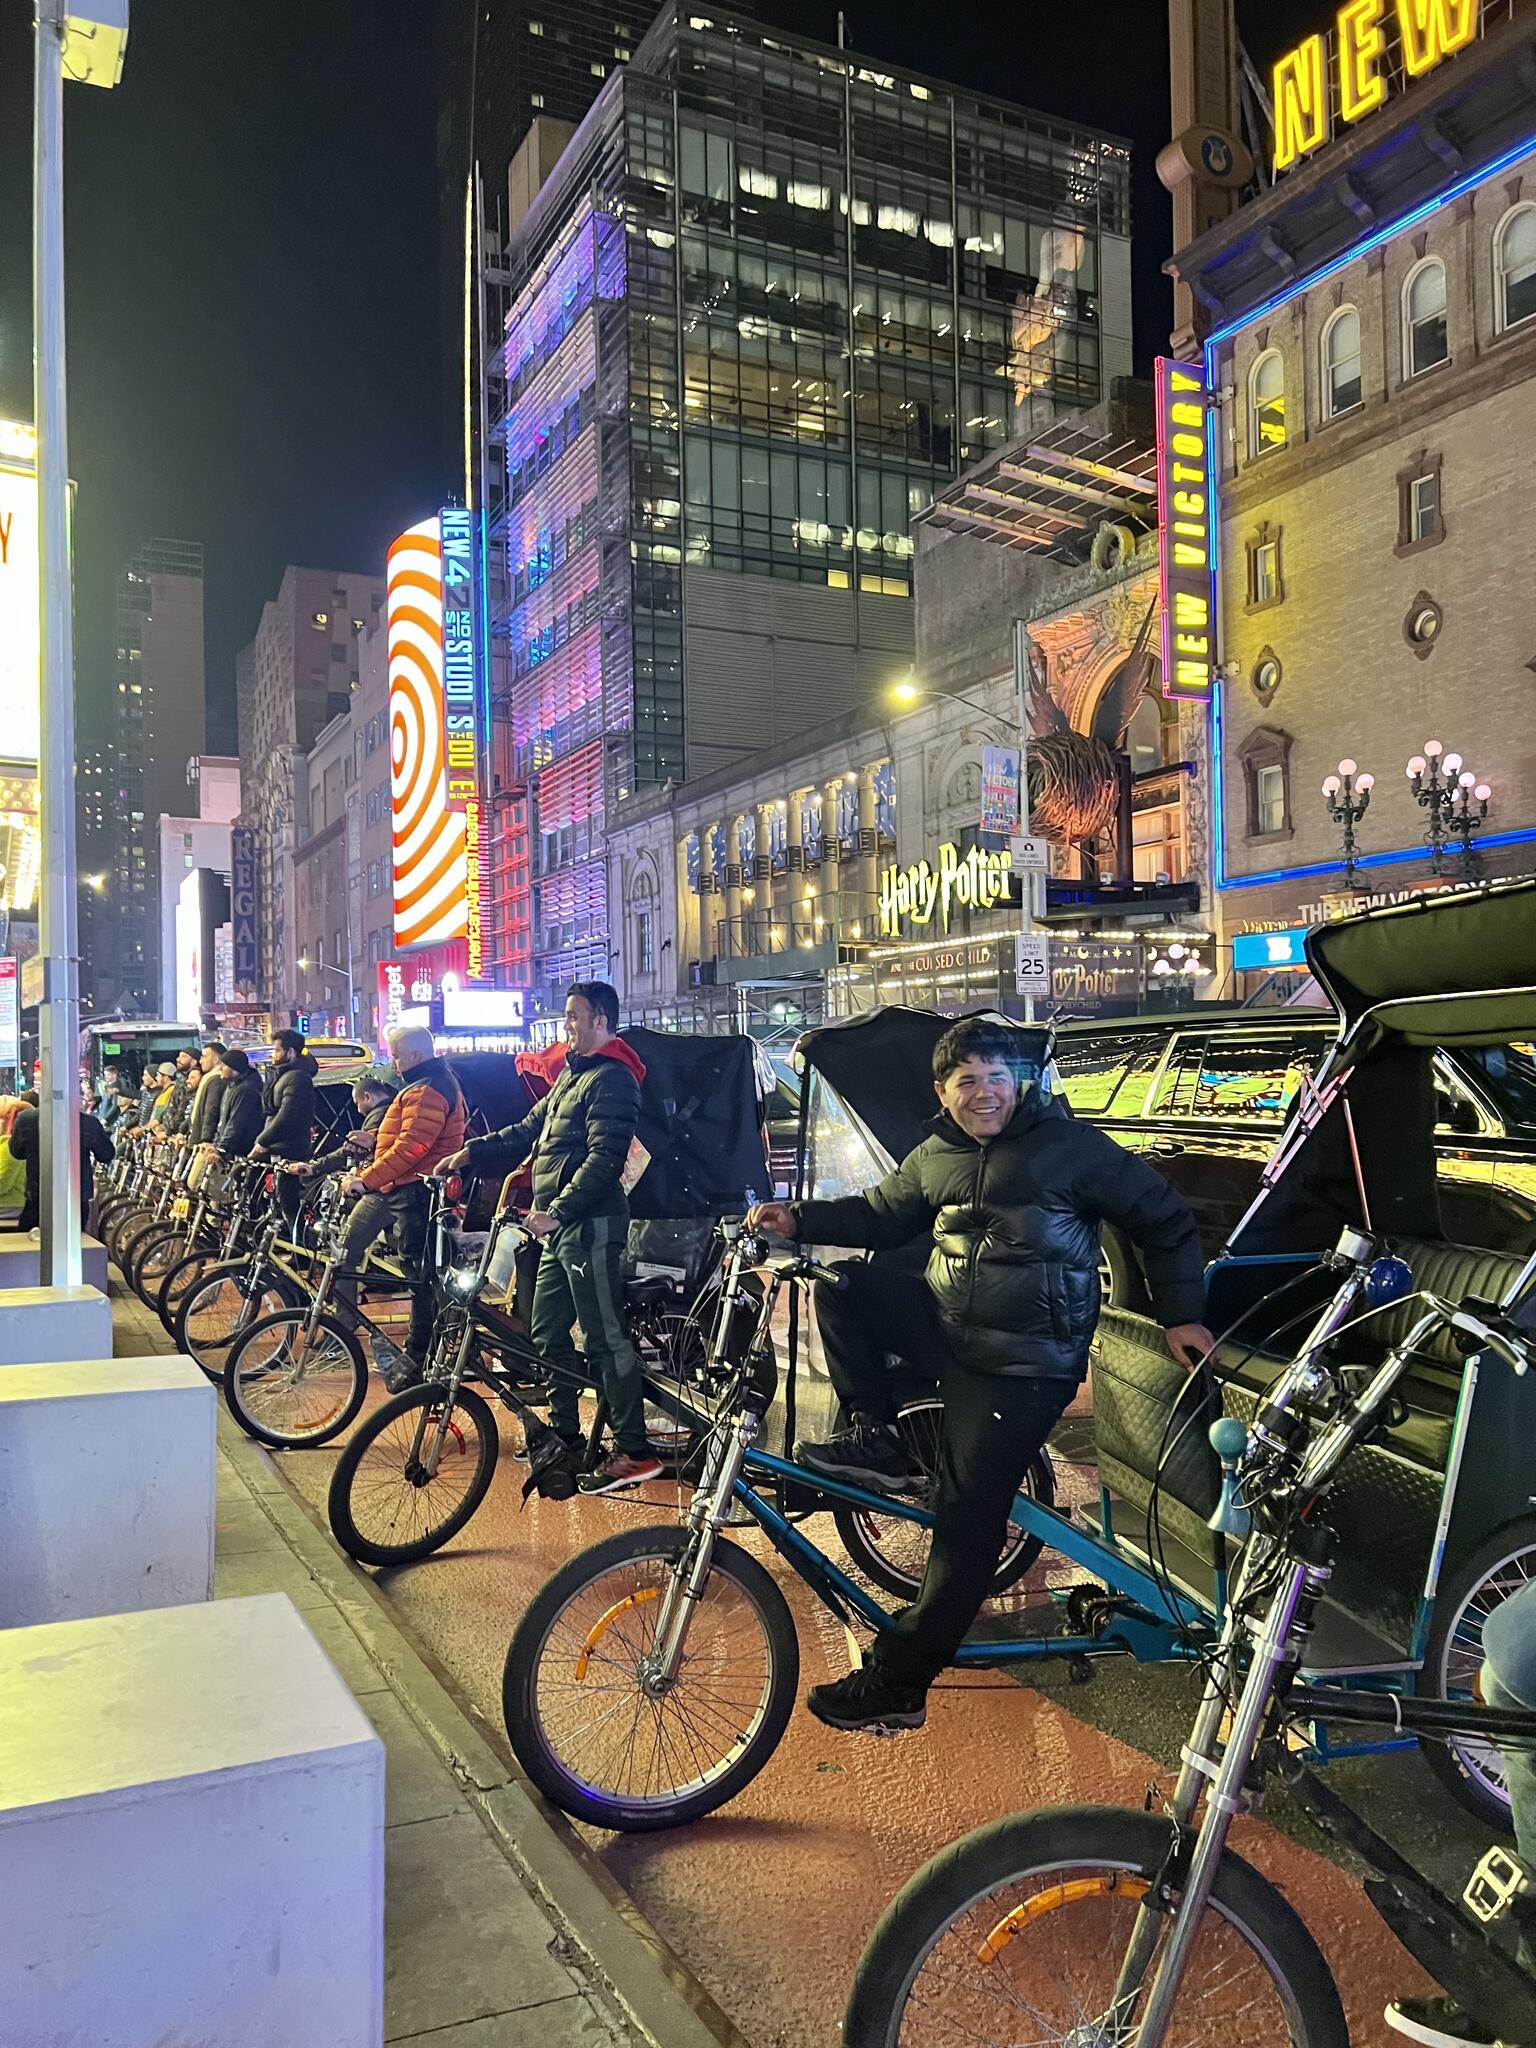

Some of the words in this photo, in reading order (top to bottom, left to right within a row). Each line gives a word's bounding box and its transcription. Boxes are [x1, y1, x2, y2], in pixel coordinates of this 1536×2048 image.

[1272, 0, 1479, 171] NEW
[1170, 371, 1208, 566] VICTORY
[442, 509, 472, 558] NEW
[444, 559, 472, 609] 42
[445, 610, 457, 638] ST
[1175, 592, 1210, 687] NEW
[445, 639, 475, 729] STUDIOS
[447, 731, 475, 740] THE
[448, 740, 476, 791] DUKE
[463, 802, 479, 857] Theatre
[234, 835, 254, 971] REGAL
[877, 859, 940, 938] Harry
[937, 841, 1014, 935] Potter
[467, 909, 482, 979] American
[1021, 958, 1044, 974] 25
[384, 964, 406, 1023] target
[1073, 963, 1119, 1000] Potter
